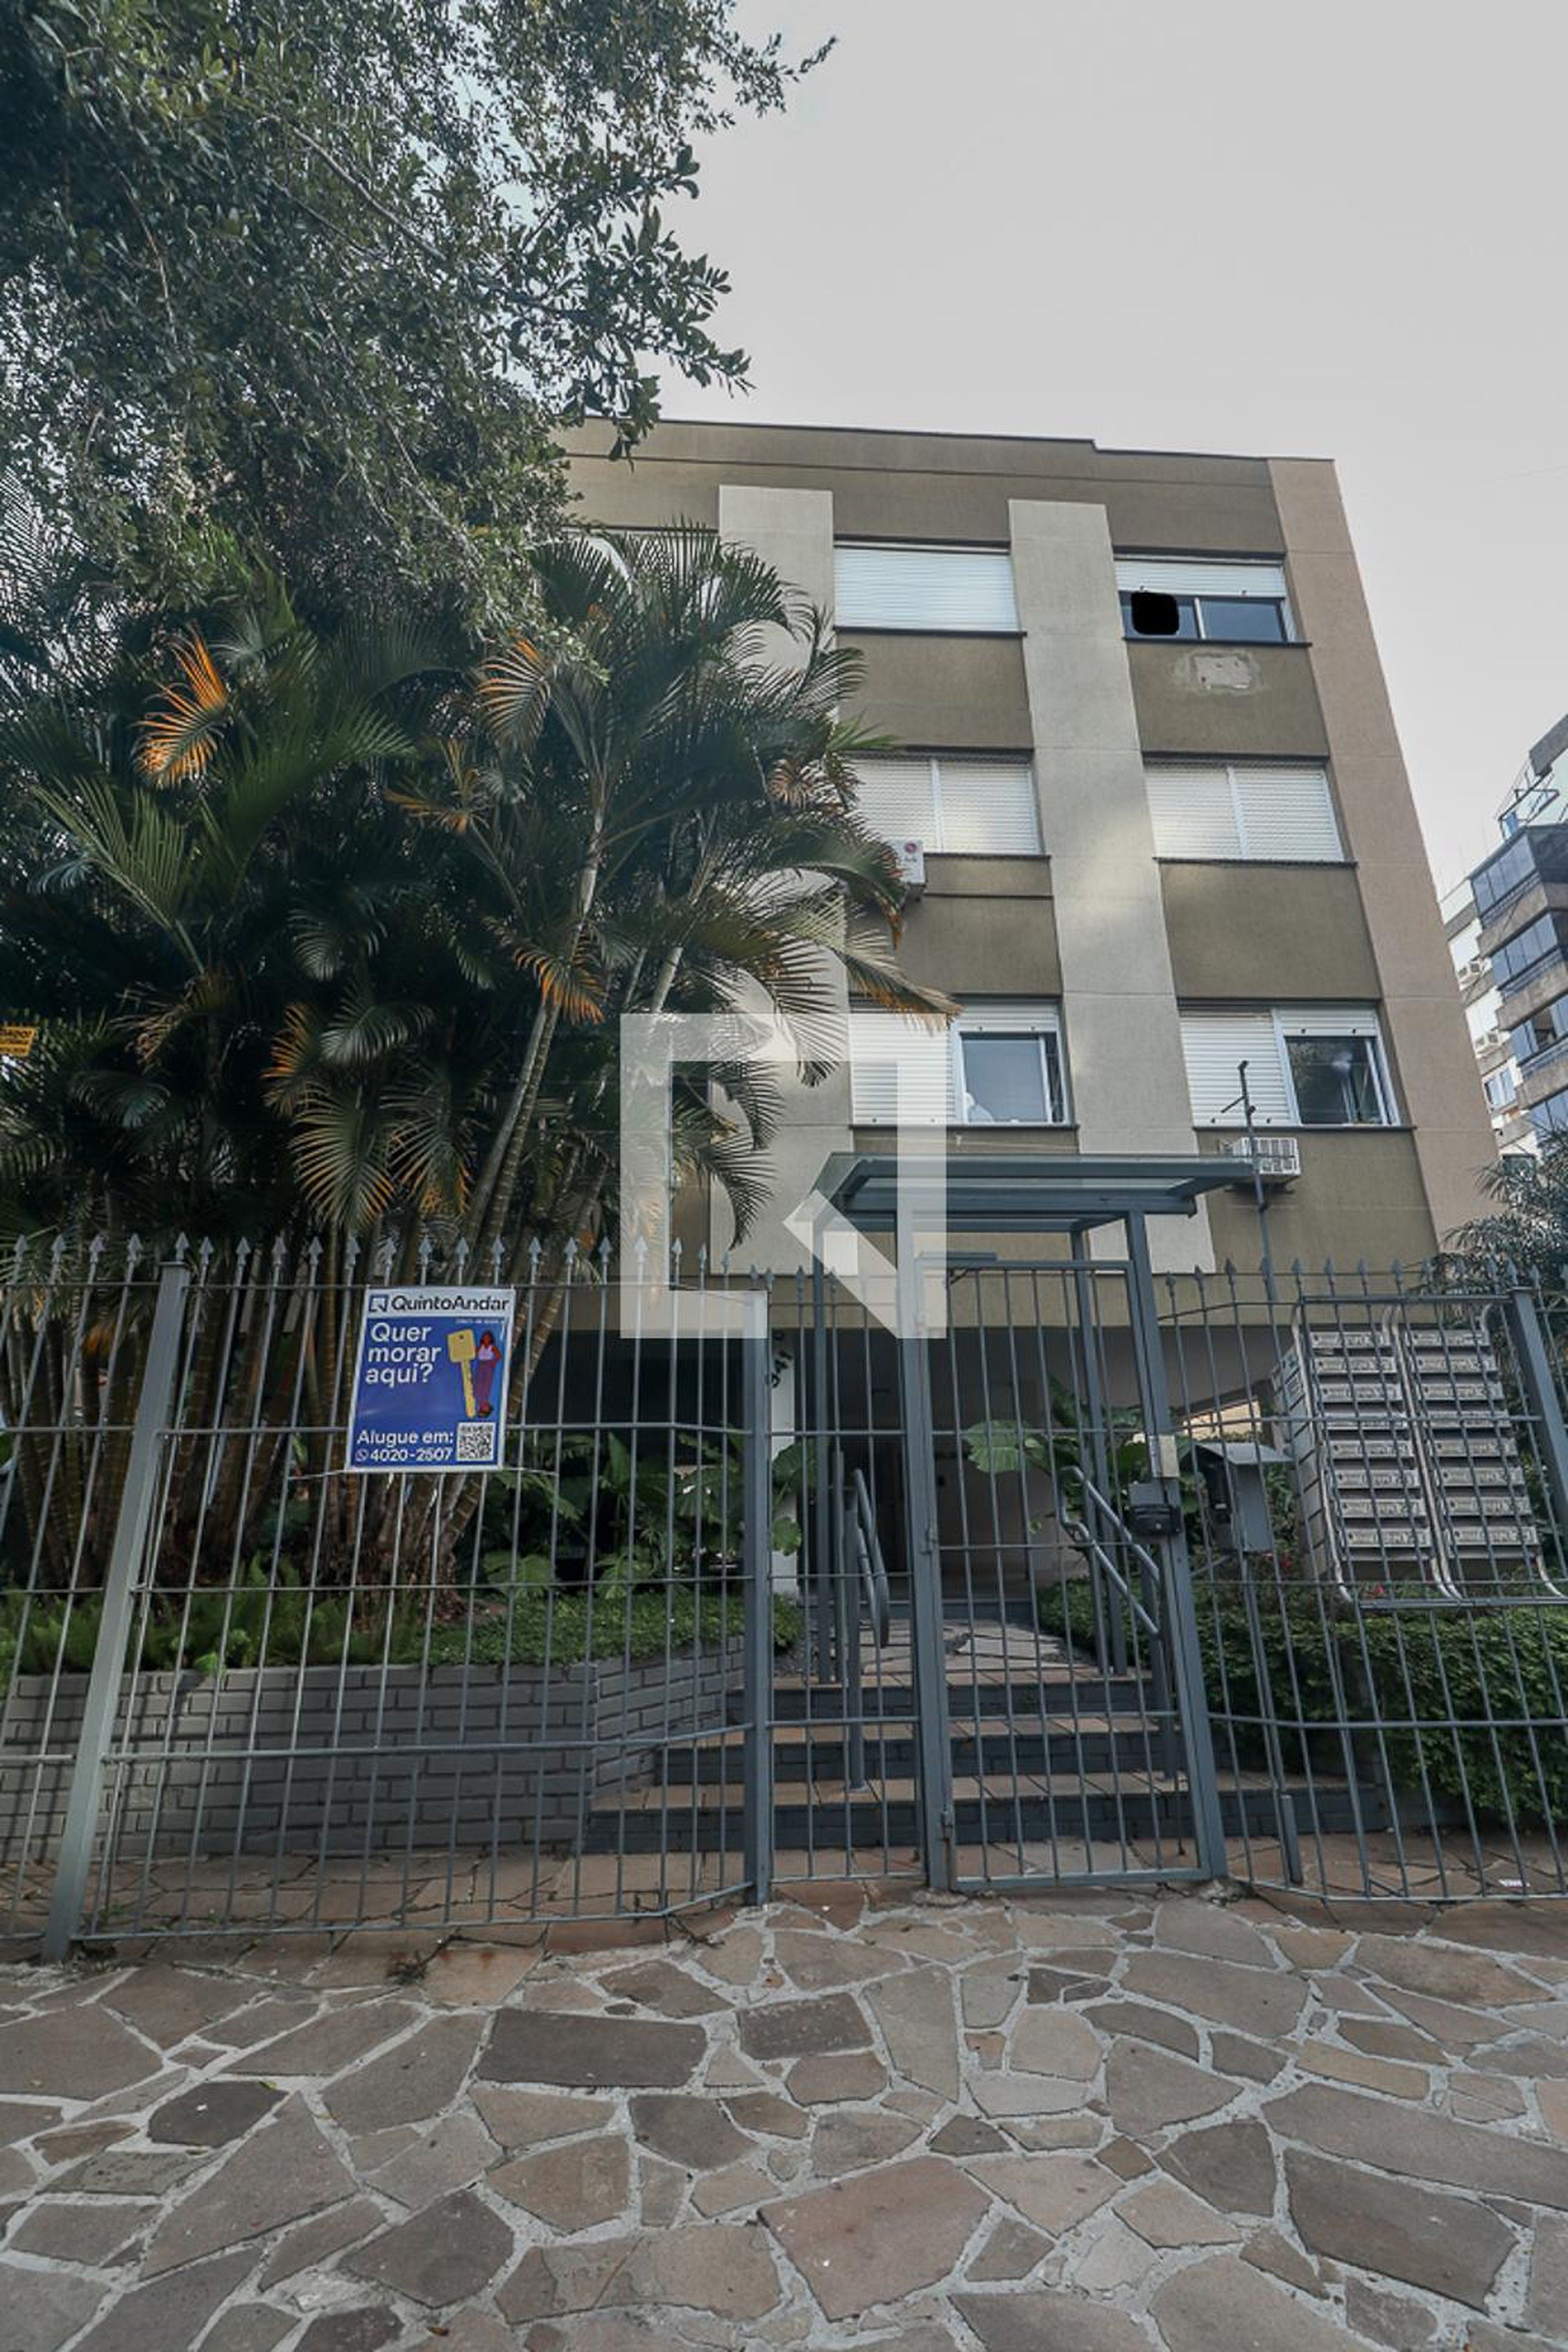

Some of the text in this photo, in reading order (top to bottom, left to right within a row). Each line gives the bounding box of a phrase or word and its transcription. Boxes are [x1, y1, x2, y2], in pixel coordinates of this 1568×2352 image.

[391, 1295, 509, 1310] QuintoAndar
[370, 1322, 432, 1342] Quer
[368, 1347, 442, 1362] morar
[365, 1363, 433, 1388] aqui?
[356, 1430, 454, 1448] Alugue em:
